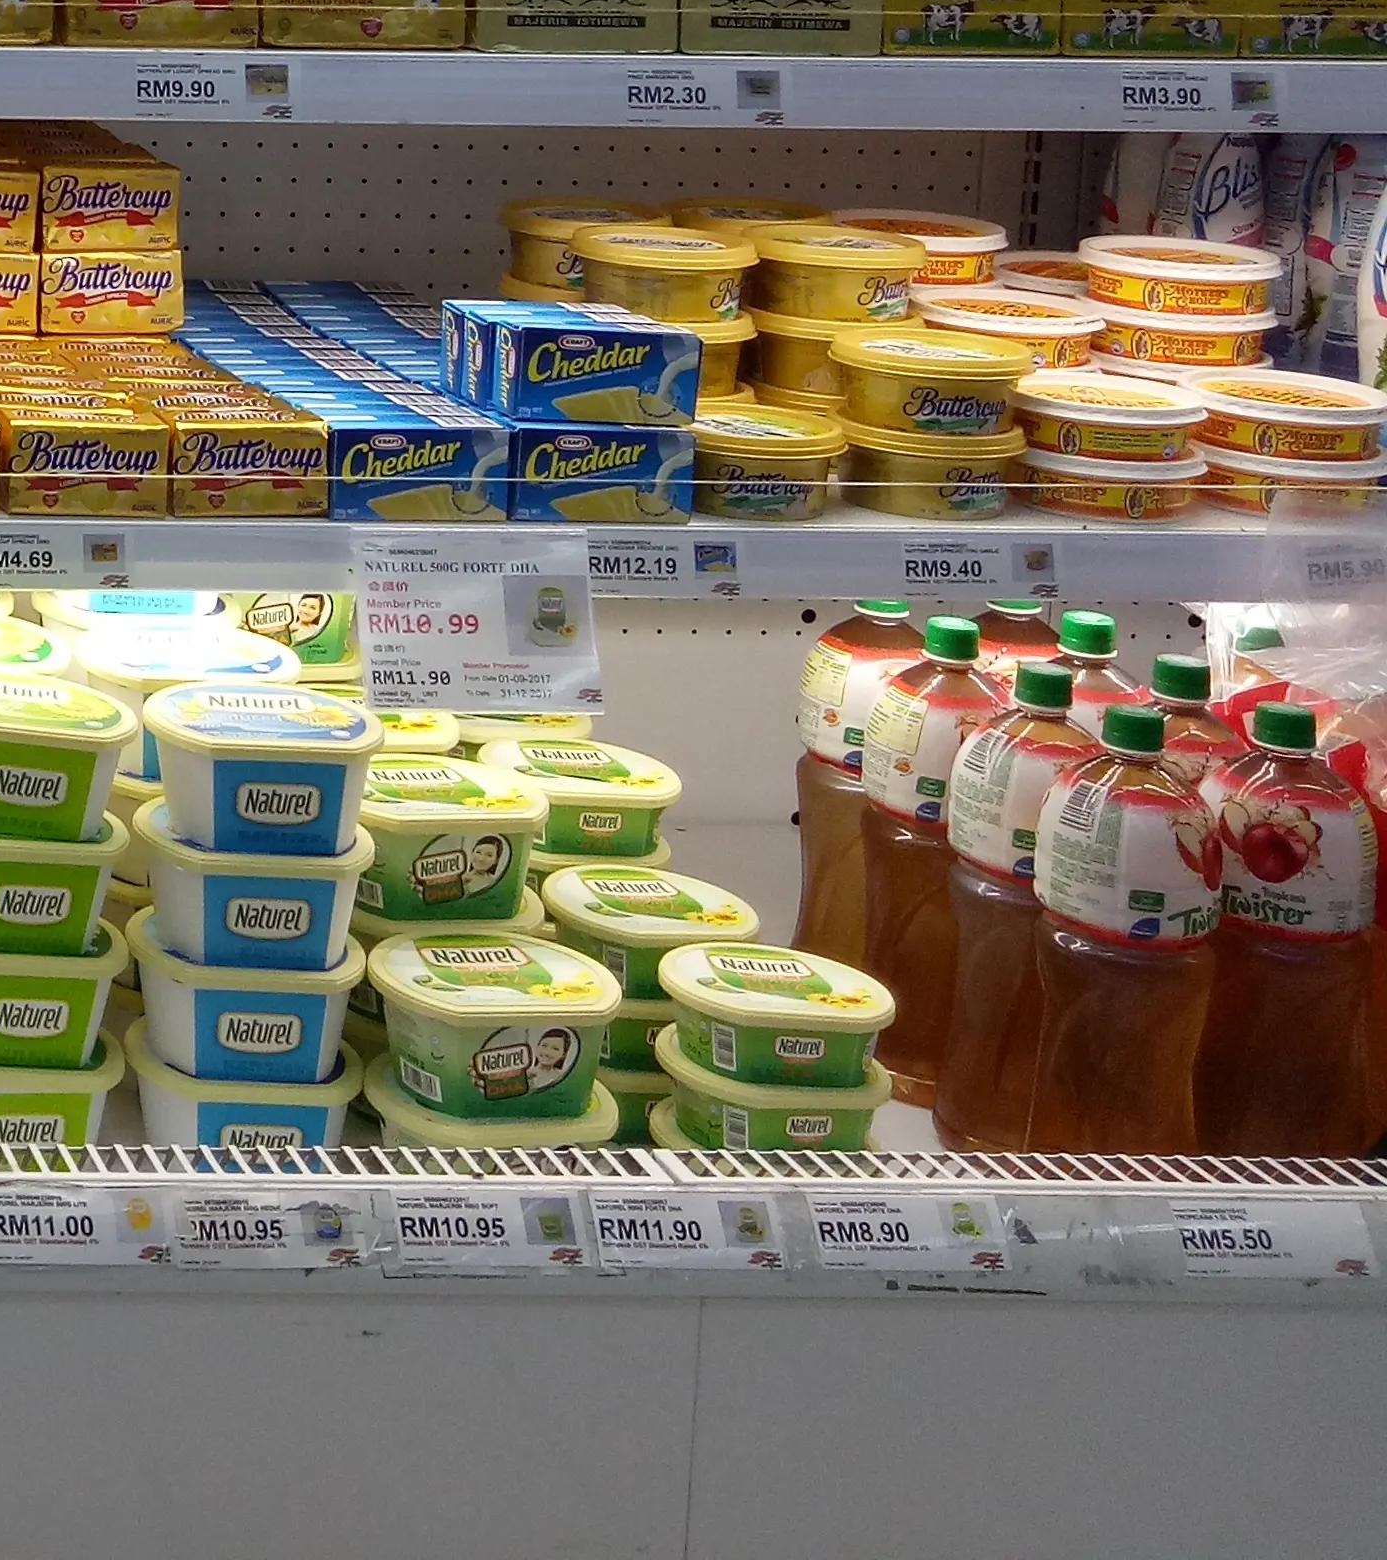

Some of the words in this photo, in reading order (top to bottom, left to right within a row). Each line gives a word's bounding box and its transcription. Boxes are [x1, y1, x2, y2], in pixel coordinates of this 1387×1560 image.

[511, 17, 572, 27] MAJERIN
[577, 17, 644, 29] ISTIMEWA
[136, 79, 215, 101] RM9.90
[628, 85, 706, 106] RM2.30
[1122, 86, 1202, 106] RM3.90
[528, 339, 651, 383] Cheddar
[903, 386, 1007, 424] Buttercup
[11, 432, 160, 473] Buttercup
[343, 437, 461, 483] Cheddar
[365, 562, 427, 573] NATUREL
[430, 563, 458, 572] 500G
[463, 562, 505, 573] FORTE
[511, 563, 539, 573] DHA
[589, 556, 678, 576] RM12.19
[904, 559, 982, 579] RM9.40
[367, 599, 410, 609] Member
[414, 600, 441, 609] Price
[369, 615, 479, 634] RM10.99
[373, 671, 450, 685] RM11.90
[498, 674, 550, 683] 01-09-2017
[244, 790, 312, 817] Naturel
[429, 947, 519, 964] Naturel
[481, 1050, 525, 1071] Naturel
[400, 1217, 505, 1240] RM10.95
[598, 1218, 702, 1241] RM11.90
[819, 1220, 909, 1244] RM8.90
[1181, 1227, 1273, 1250] RM5.50
